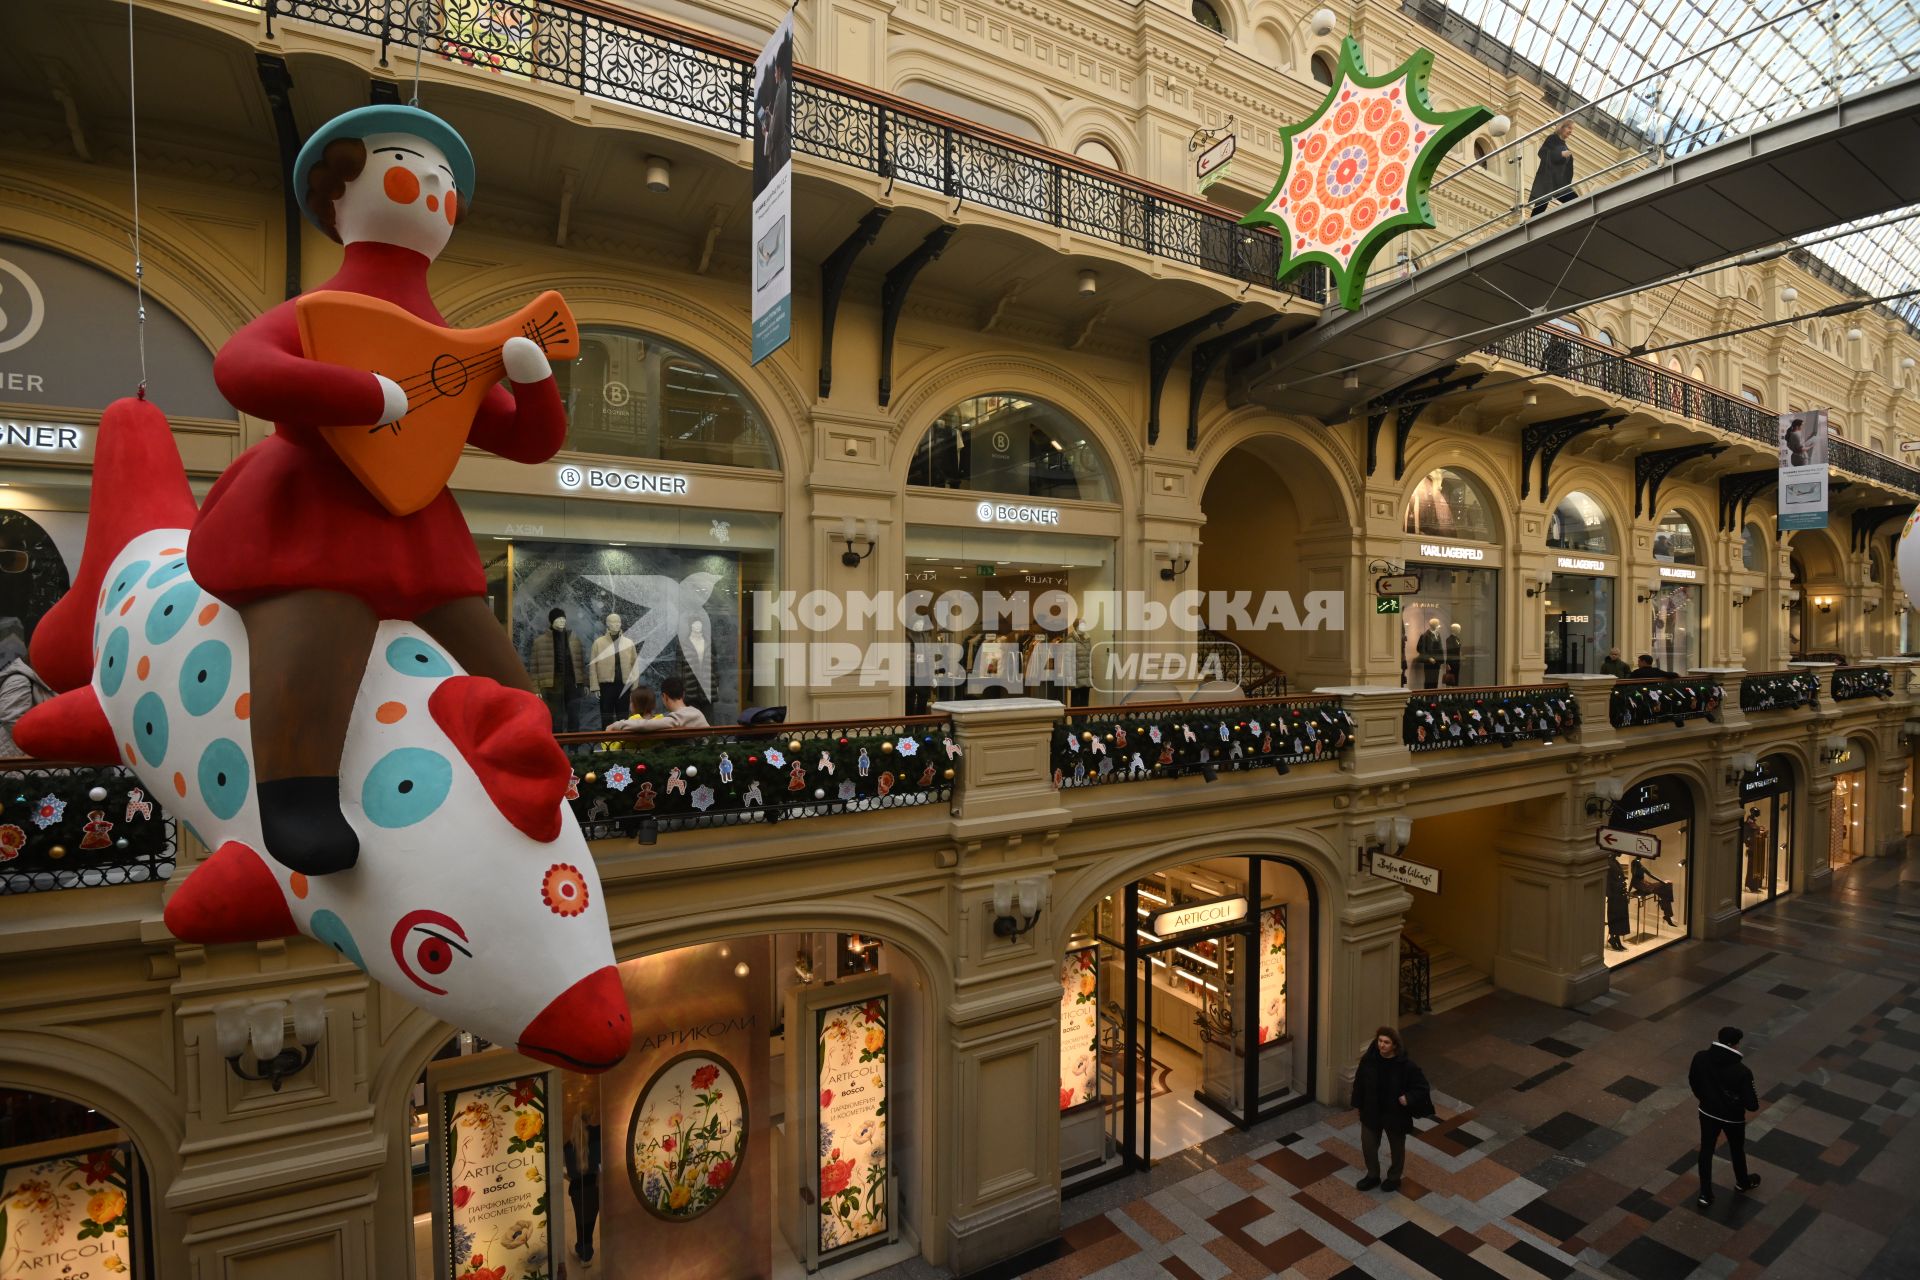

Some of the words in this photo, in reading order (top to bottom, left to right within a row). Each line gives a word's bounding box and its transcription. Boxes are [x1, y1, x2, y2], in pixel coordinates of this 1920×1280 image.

[0, 372, 44, 392] ER
[0, 424, 78, 449] NER
[590, 470, 686, 494] BOGNER
[998, 506, 1059, 524] BOGNER
[1421, 545, 1441, 557] KARL
[1442, 546, 1483, 560] LAGERFELD
[1174, 906, 1231, 927] ARTICOLI
[1063, 1006, 1091, 1019] TICOLI
[640, 1015, 757, 1052] АРТИКОЛИ
[1063, 1025, 1080, 1034] BOSCO
[828, 1065, 878, 1085] ARTICOLI
[841, 1086, 865, 1097] BOSCO
[830, 1096, 876, 1114] ПАРФЮМЕРИЯ
[463, 1154, 535, 1181] ARTICOLI
[483, 1180, 516, 1195] BOSCO
[468, 1192, 532, 1214] ПАРФЮМЕРИЯ
[468, 1214, 476, 1224] И
[478, 1201, 532, 1221] КОСМЕТИКА
[17, 1239, 116, 1273] ARTICOLI
